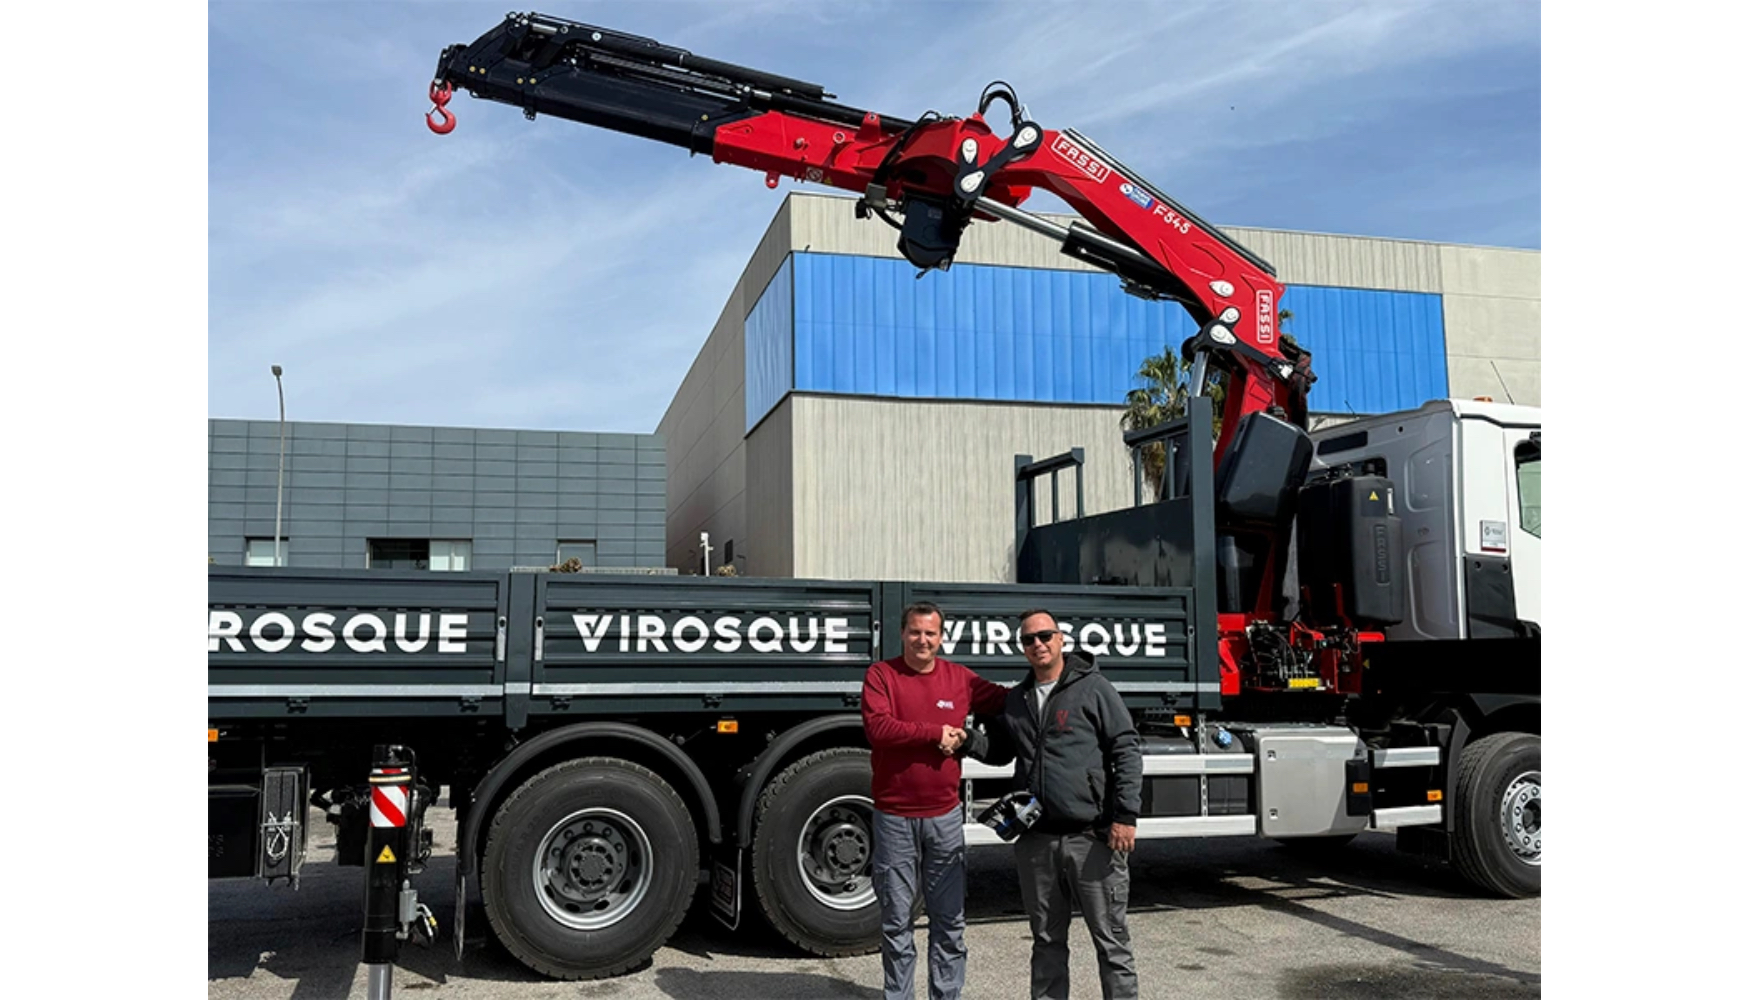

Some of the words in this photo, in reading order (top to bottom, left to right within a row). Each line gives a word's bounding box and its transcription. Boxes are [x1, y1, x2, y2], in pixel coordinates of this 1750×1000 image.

[1057, 140, 1105, 178] FASSI
[1260, 294, 1271, 339] FASSI
[1376, 526, 1387, 582] FASSI
[208, 610, 468, 653] ROSQUE
[572, 613, 849, 653] VIROSQUE
[942, 620, 1167, 657] VIRSQUE
